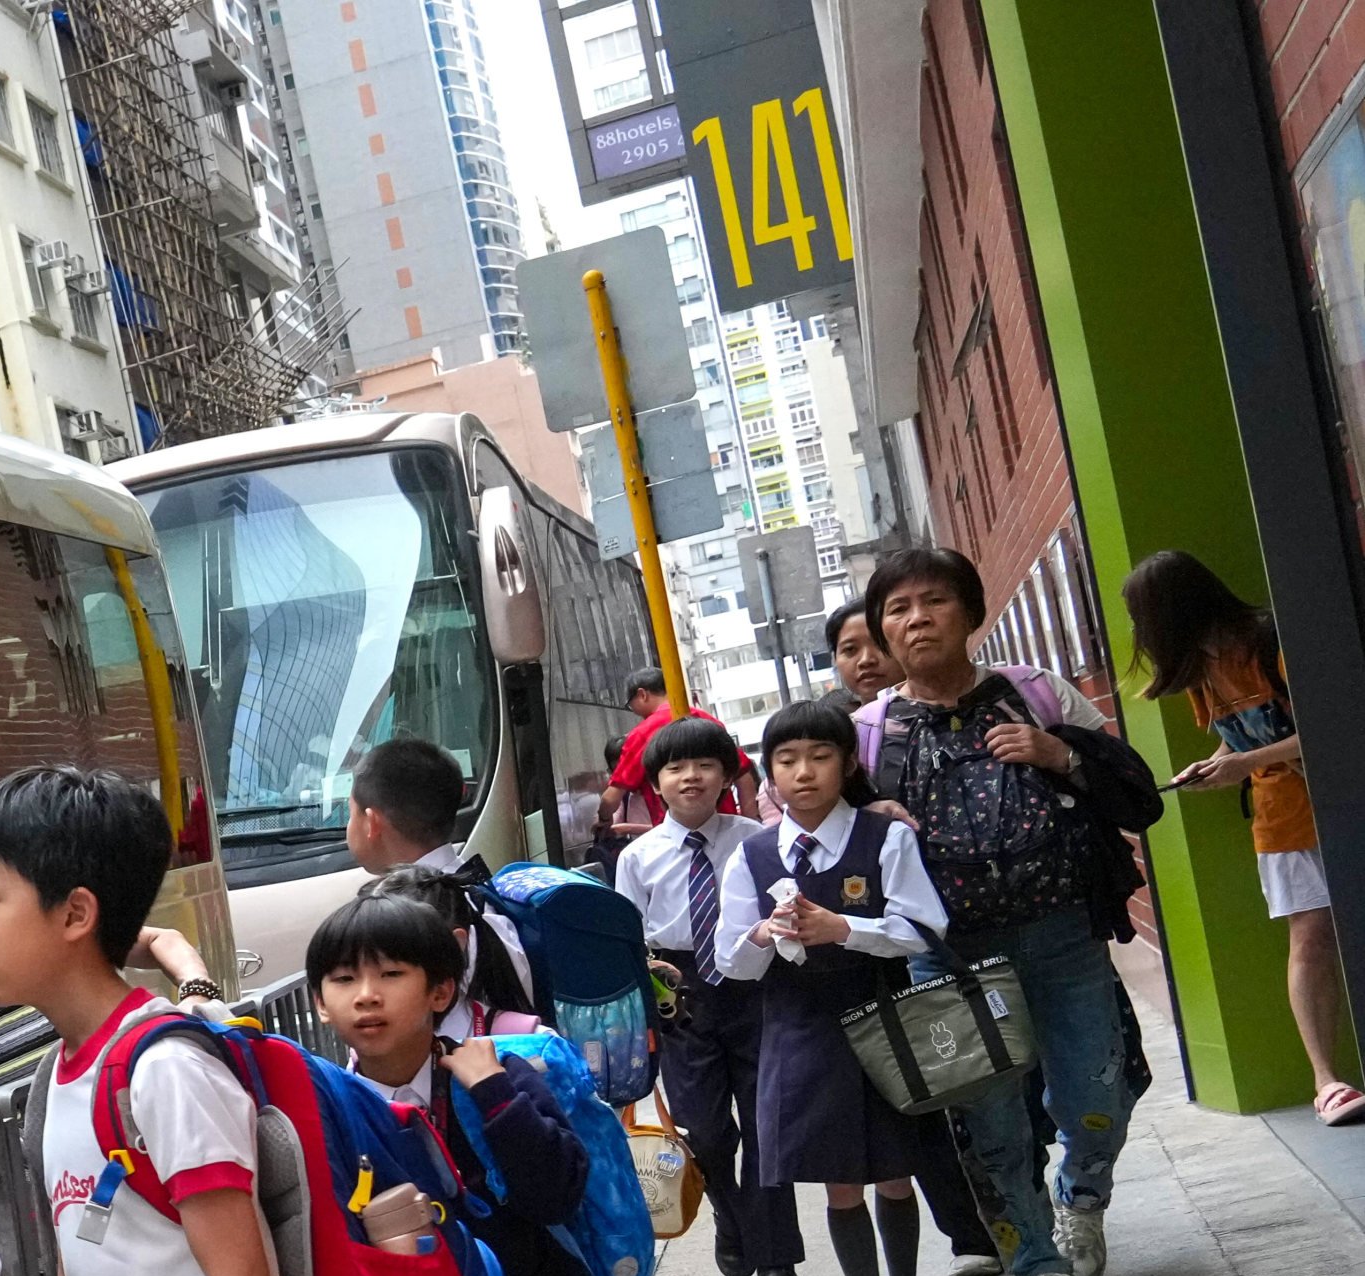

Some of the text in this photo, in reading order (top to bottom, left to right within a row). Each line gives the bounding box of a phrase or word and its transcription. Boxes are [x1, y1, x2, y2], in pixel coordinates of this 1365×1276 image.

[595, 110, 681, 150] 88hotels.
[621, 138, 669, 165] 2905
[691, 87, 854, 289] 141
[896, 975, 946, 999] LIFEWORK
